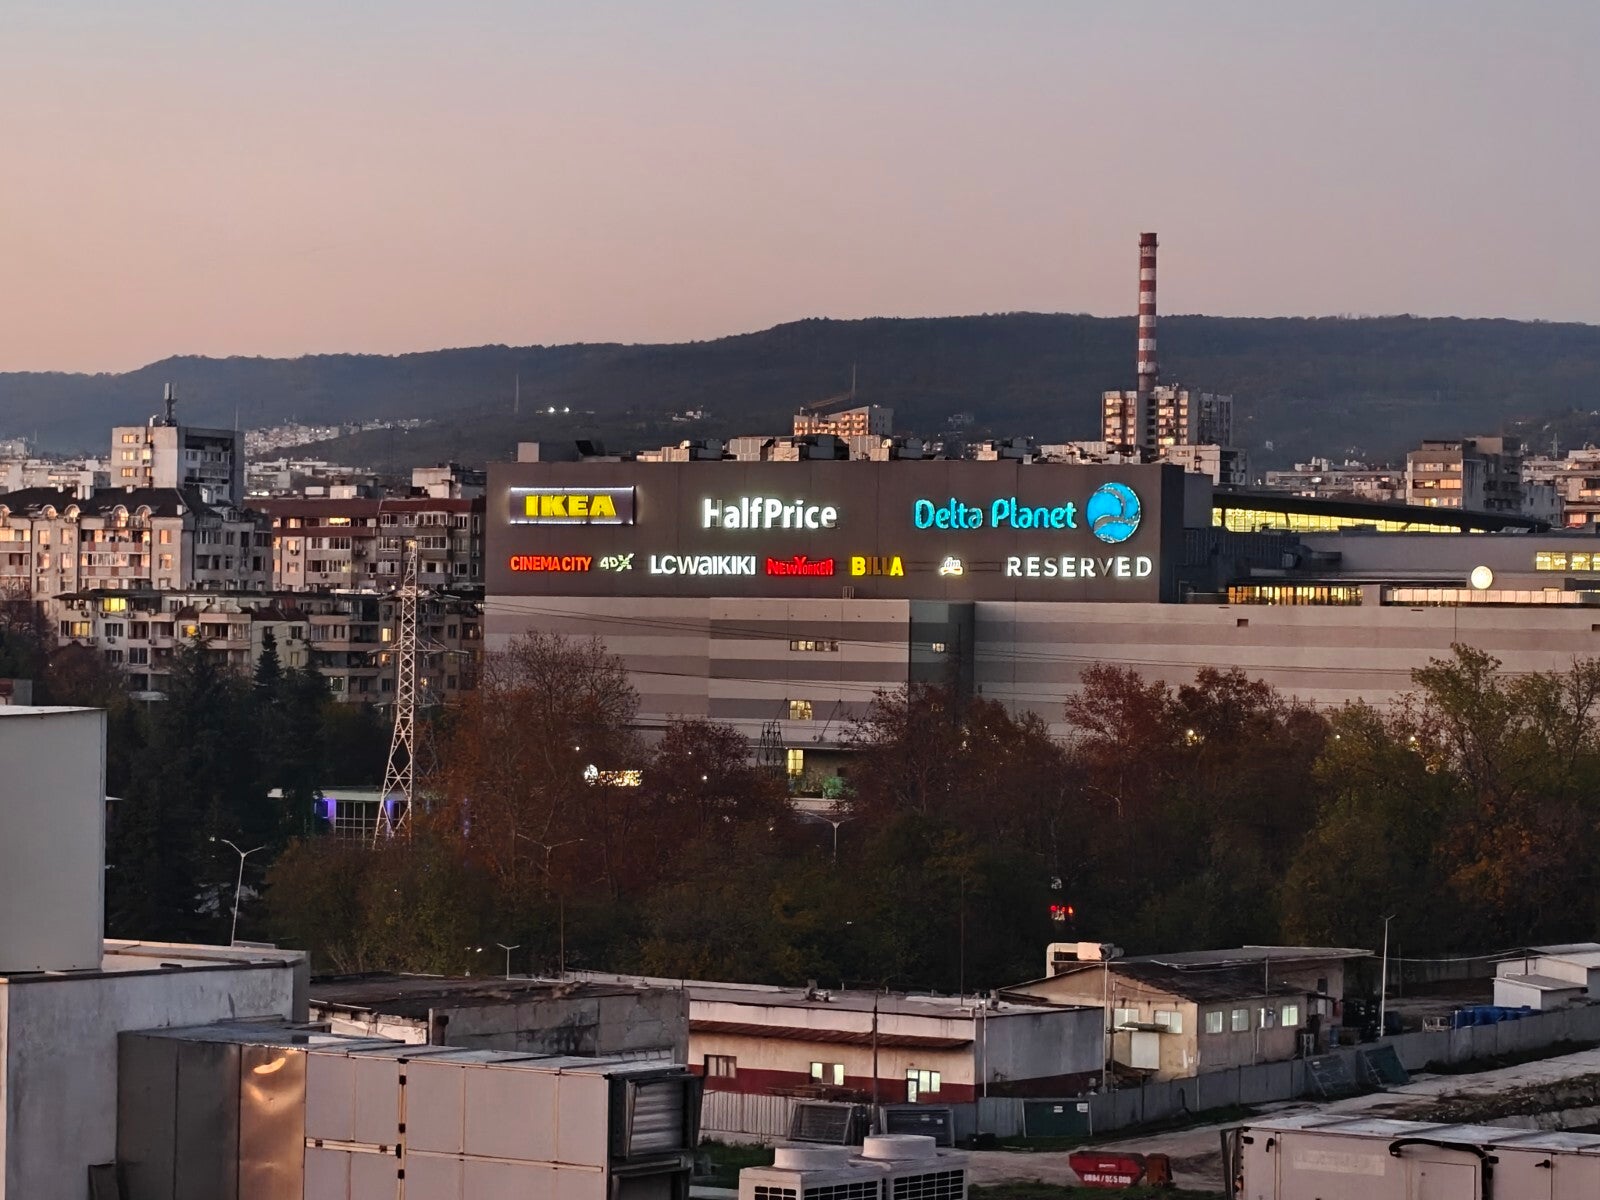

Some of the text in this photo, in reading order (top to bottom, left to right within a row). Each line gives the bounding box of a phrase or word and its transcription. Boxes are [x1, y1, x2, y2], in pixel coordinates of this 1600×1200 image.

[525, 495, 617, 517] IKEA
[703, 497, 838, 529] HalfPrice
[913, 497, 1078, 529] Delta Planet
[510, 556, 561, 571] CINEMA
[562, 556, 592, 571] CITY
[851, 556, 904, 576] BILLA
[1006, 556, 1153, 577] RESERVED
